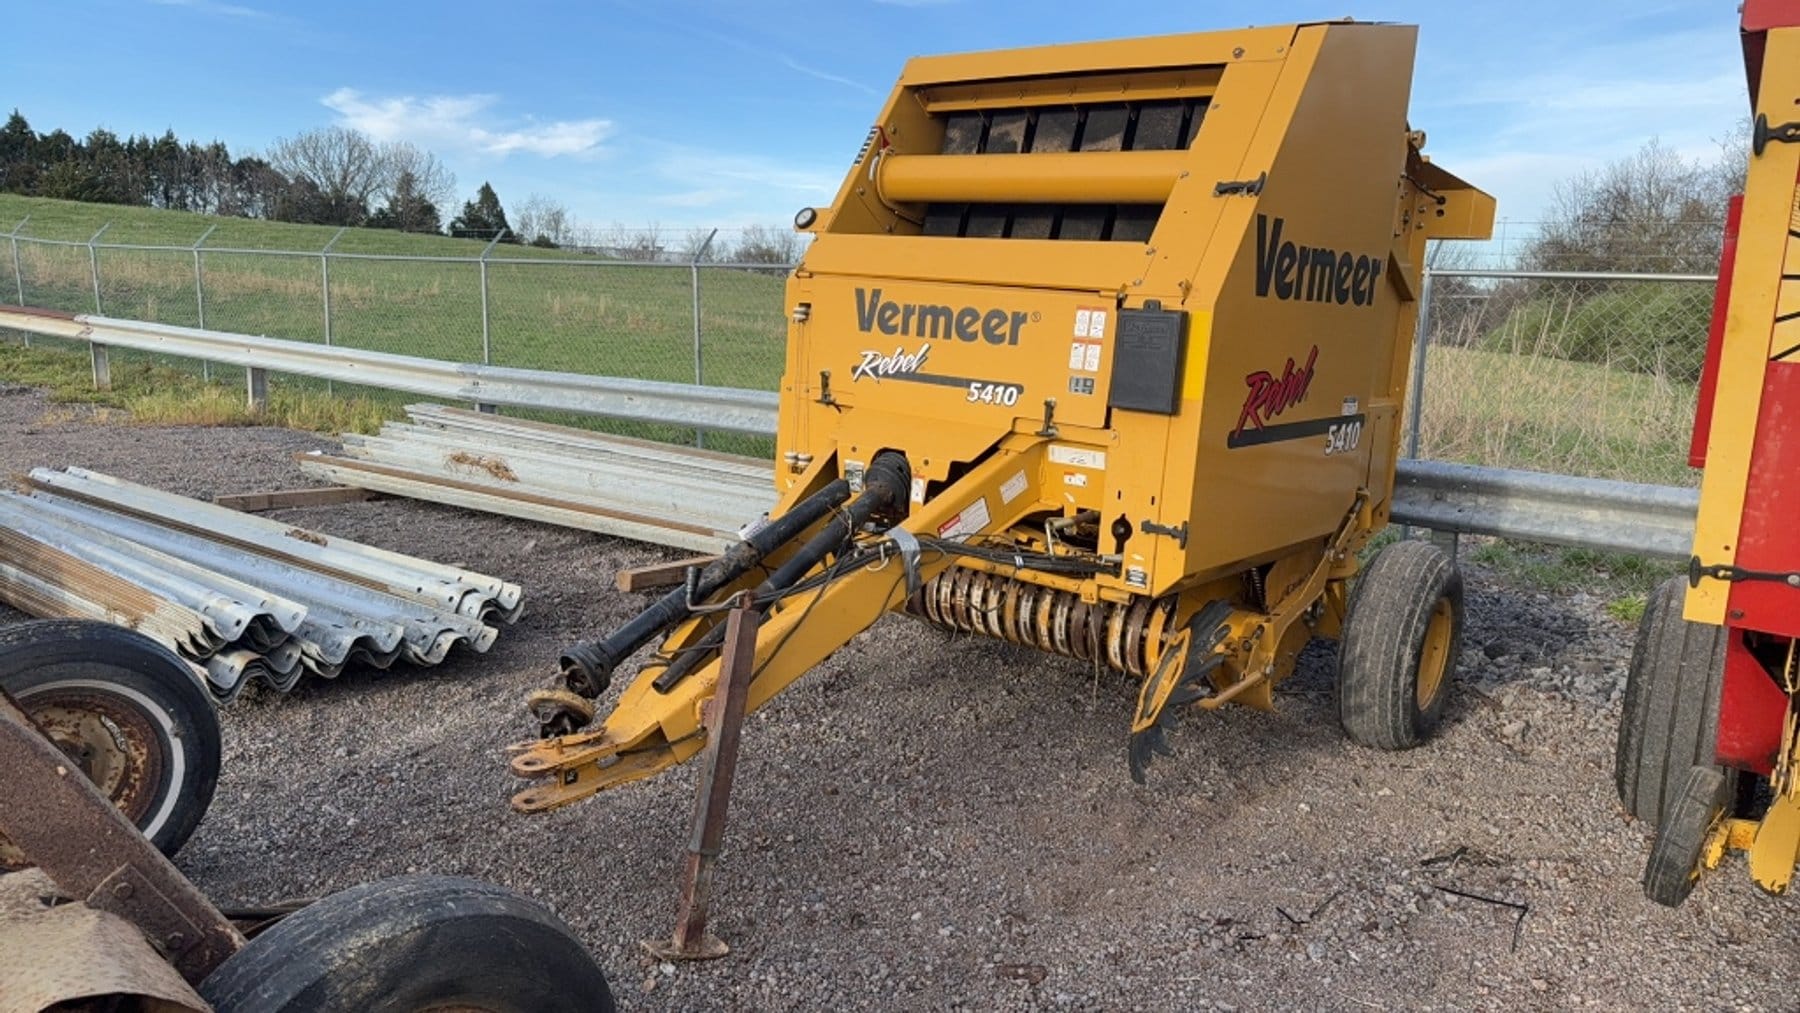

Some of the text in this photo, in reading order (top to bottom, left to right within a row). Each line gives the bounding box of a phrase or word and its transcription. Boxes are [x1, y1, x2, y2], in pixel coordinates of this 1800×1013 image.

[1256, 213, 1381, 306] Vermeer
[855, 288, 1028, 345] Vermeer
[853, 344, 930, 382] Rebel
[967, 382, 1018, 406] 5410
[1235, 344, 1319, 438] Rebel
[1325, 423, 1361, 454] 5410
